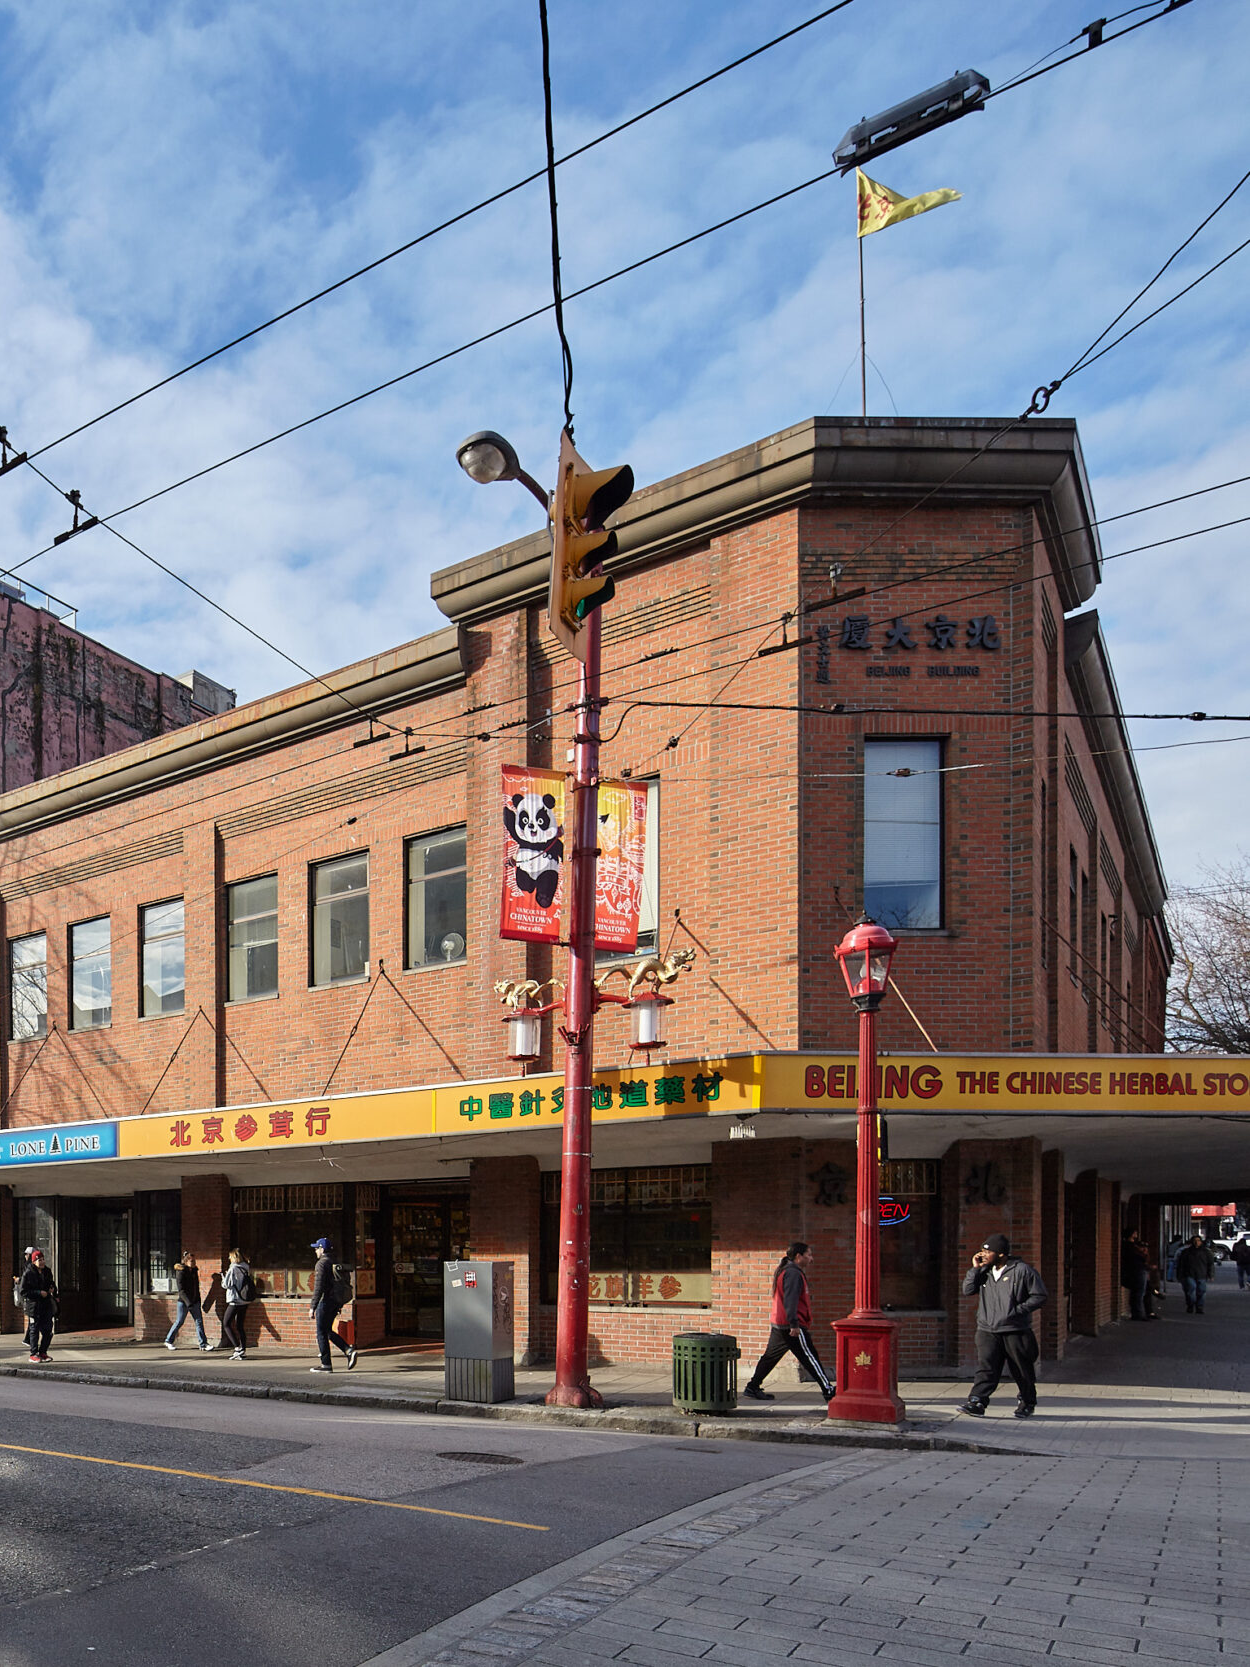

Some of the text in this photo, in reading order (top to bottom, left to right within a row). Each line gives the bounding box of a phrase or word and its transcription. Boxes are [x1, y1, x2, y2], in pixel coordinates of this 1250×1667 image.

[866, 665, 980, 677] BEIJING BUILDING
[510, 913, 552, 924] CHINATOWN
[595, 924, 630, 934] HINATOWN
[805, 1065, 943, 1099] BEIING
[956, 1071, 1000, 1094] THE
[1006, 1071, 1102, 1094] CHINESE
[1109, 1072, 1198, 1095] HERBAL
[10, 1136, 100, 1157] LONE PINE
[879, 1203, 910, 1217] PEN
